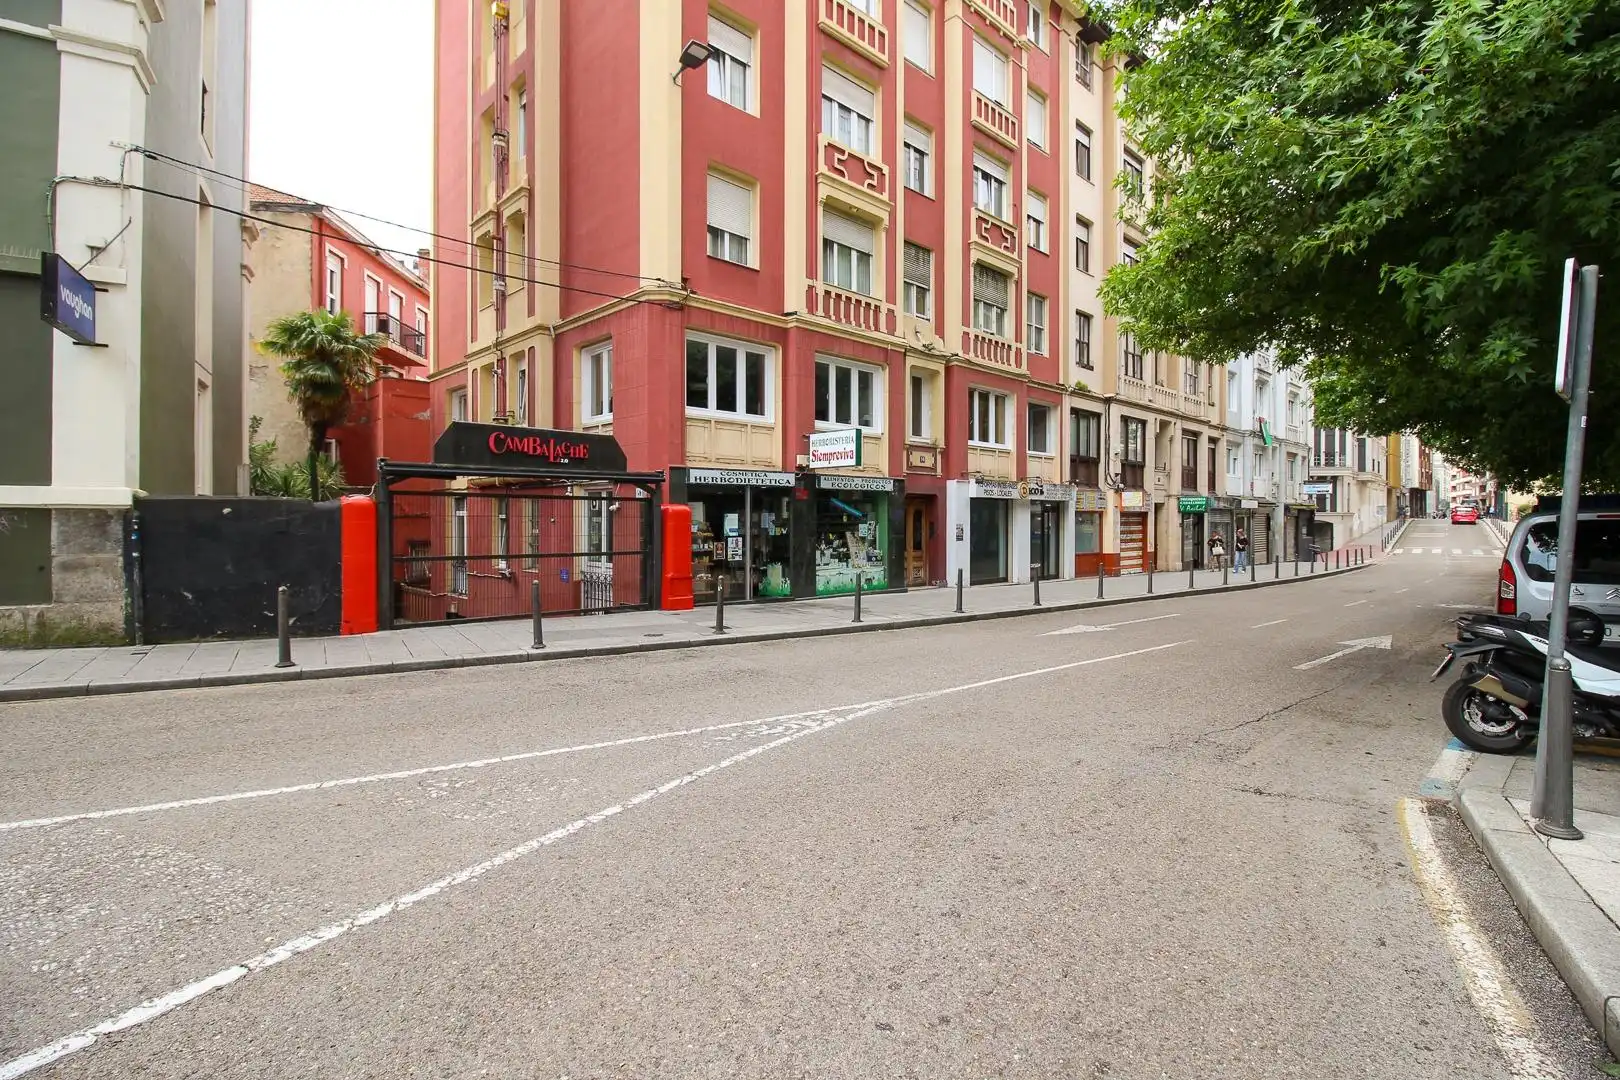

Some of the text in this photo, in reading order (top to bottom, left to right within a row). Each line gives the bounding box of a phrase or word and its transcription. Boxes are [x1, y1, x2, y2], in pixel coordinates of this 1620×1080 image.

[60, 284, 93, 320] vaughan
[811, 447, 854, 464] Siempreviva
[694, 476, 791, 485] HERBODIETETICA
[831, 482, 887, 490] ECOLOGICOS
